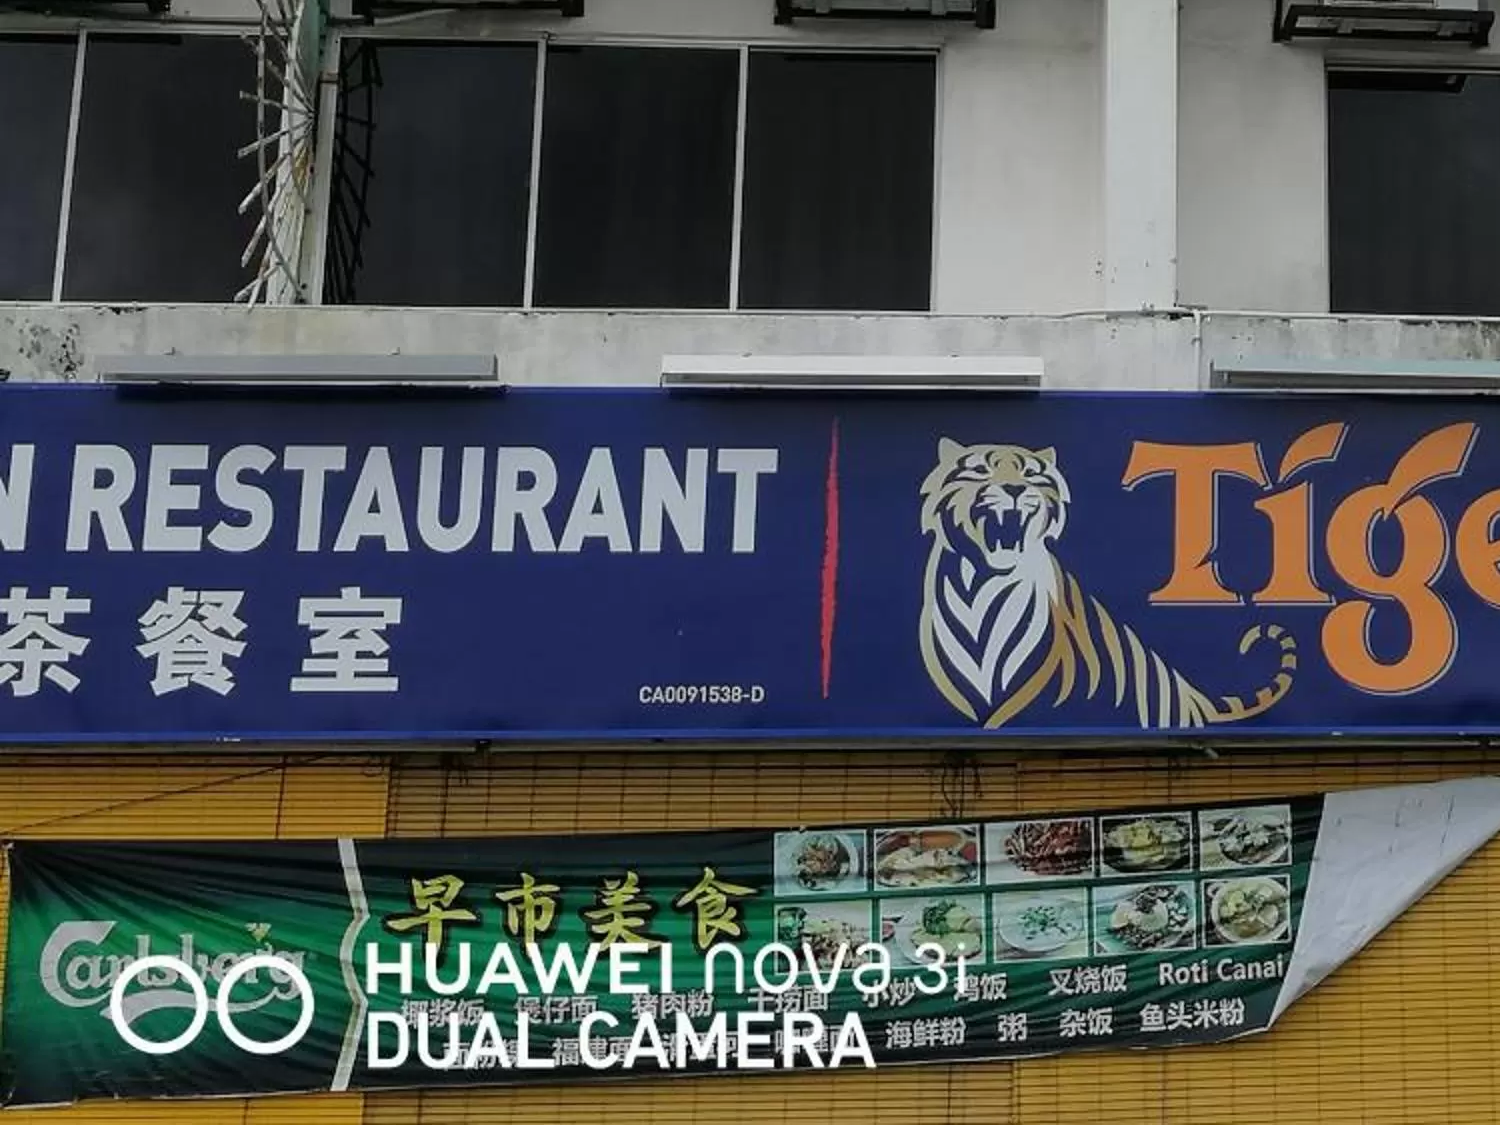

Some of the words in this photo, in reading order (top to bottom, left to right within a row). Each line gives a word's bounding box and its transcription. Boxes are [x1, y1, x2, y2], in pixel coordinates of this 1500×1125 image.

[65, 443, 779, 554] RESTAURANT
[0, 586, 403, 697] 茶餐室
[639, 685, 765, 704] CA0091538-D
[386, 867, 760, 963] 早市美食
[1048, 964, 1128, 996] 叉烧饭
[1159, 962, 1208, 986] Roti
[1216, 952, 1284, 982] Canai
[886, 1016, 967, 1049] 海鲜粉
[998, 1012, 1028, 1042] 粥
[1059, 1007, 1113, 1038] 杂饭
[1139, 998, 1245, 1033] 鱼头米粉
